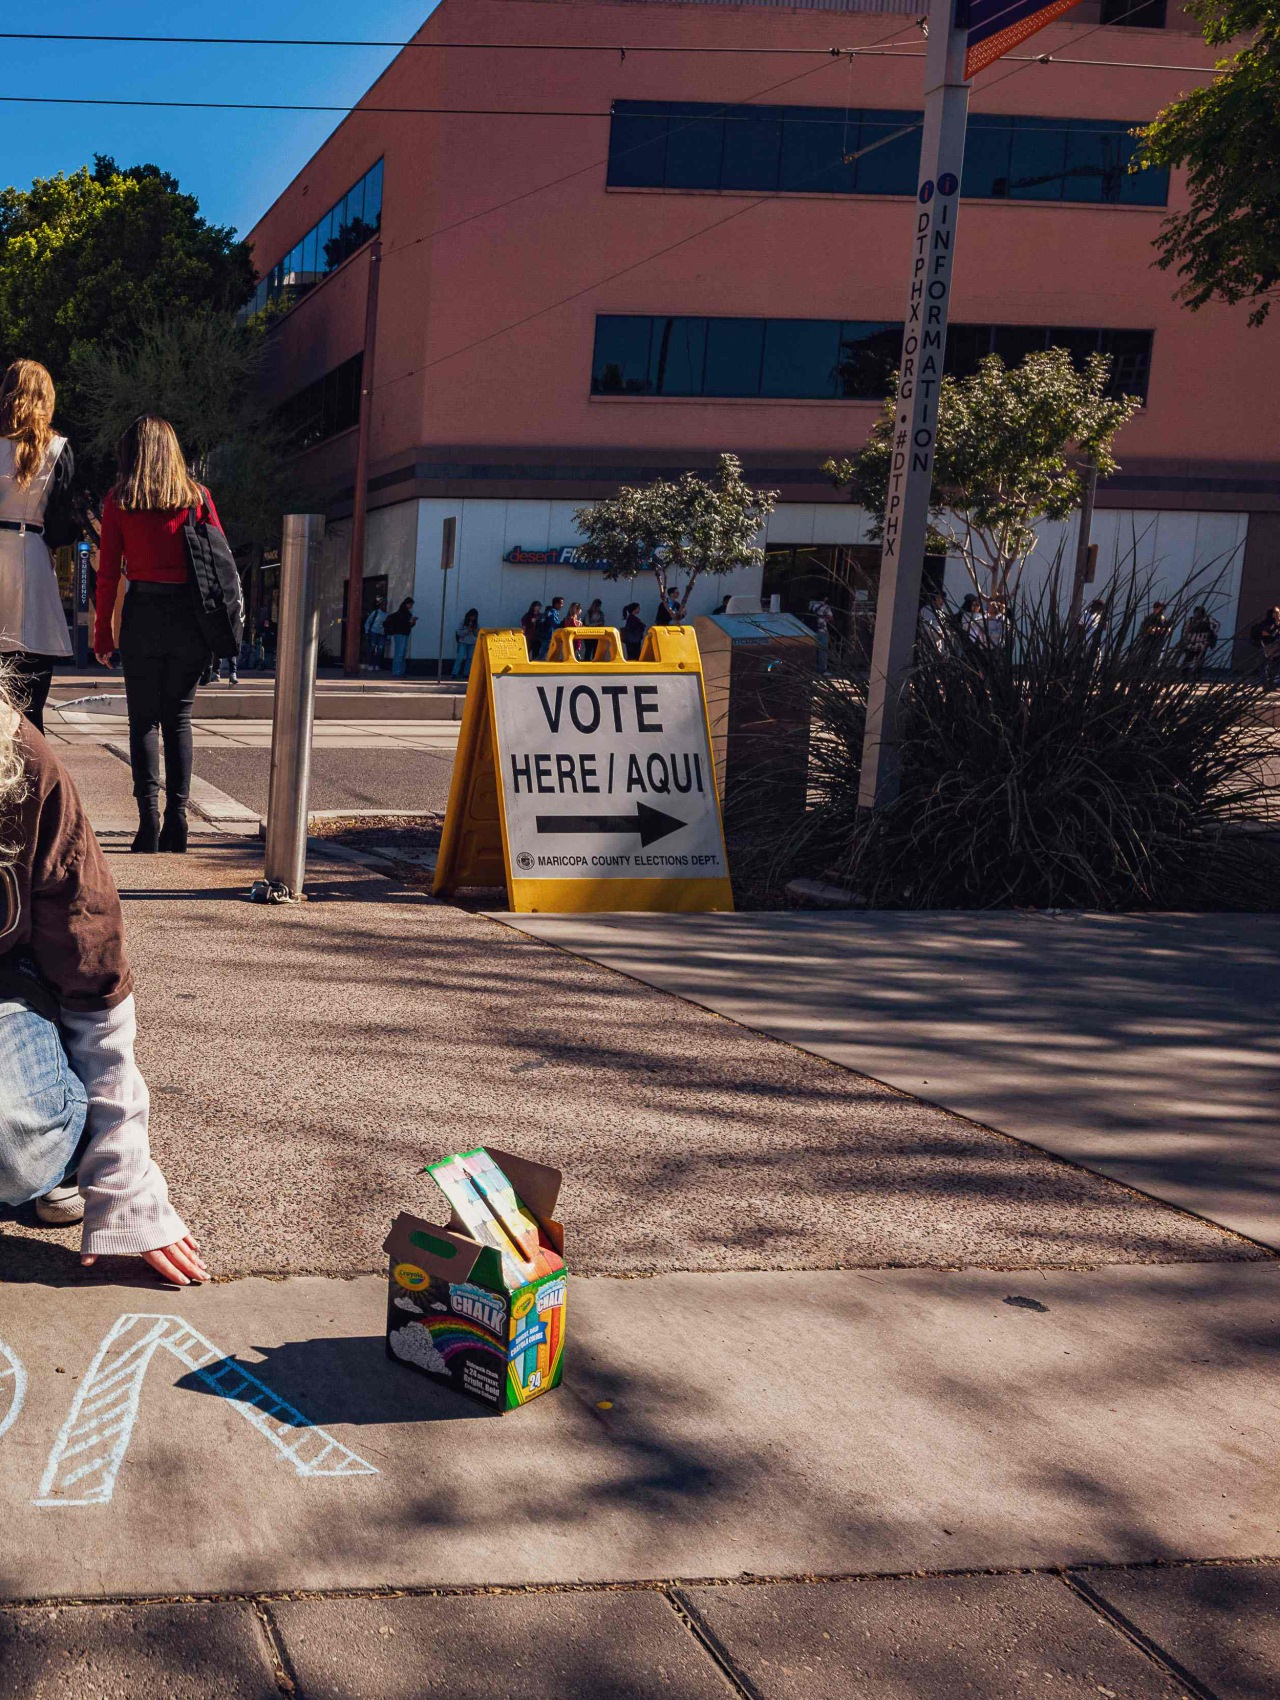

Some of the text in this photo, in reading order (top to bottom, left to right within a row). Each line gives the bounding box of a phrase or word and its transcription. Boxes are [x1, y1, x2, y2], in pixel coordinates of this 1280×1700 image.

[911, 205, 951, 472] INFORMATION
[510, 545, 557, 563] desert
[536, 684, 663, 734] VOTE
[511, 753, 600, 794] HERE
[626, 752, 704, 795] AQUI
[538, 855, 719, 866] MARICOPA COUNTY ELECTIONS DEPT.
[399, 1269, 424, 1279] Crayola
[536, 1288, 565, 1312] CHALK
[452, 1294, 504, 1332] CHALK
[510, 1331, 543, 1357] CRAYOLA COLORS
[470, 1368, 477, 1377] 24
[529, 1371, 541, 1392] 24
[485, 1383, 500, 1397] Bold
